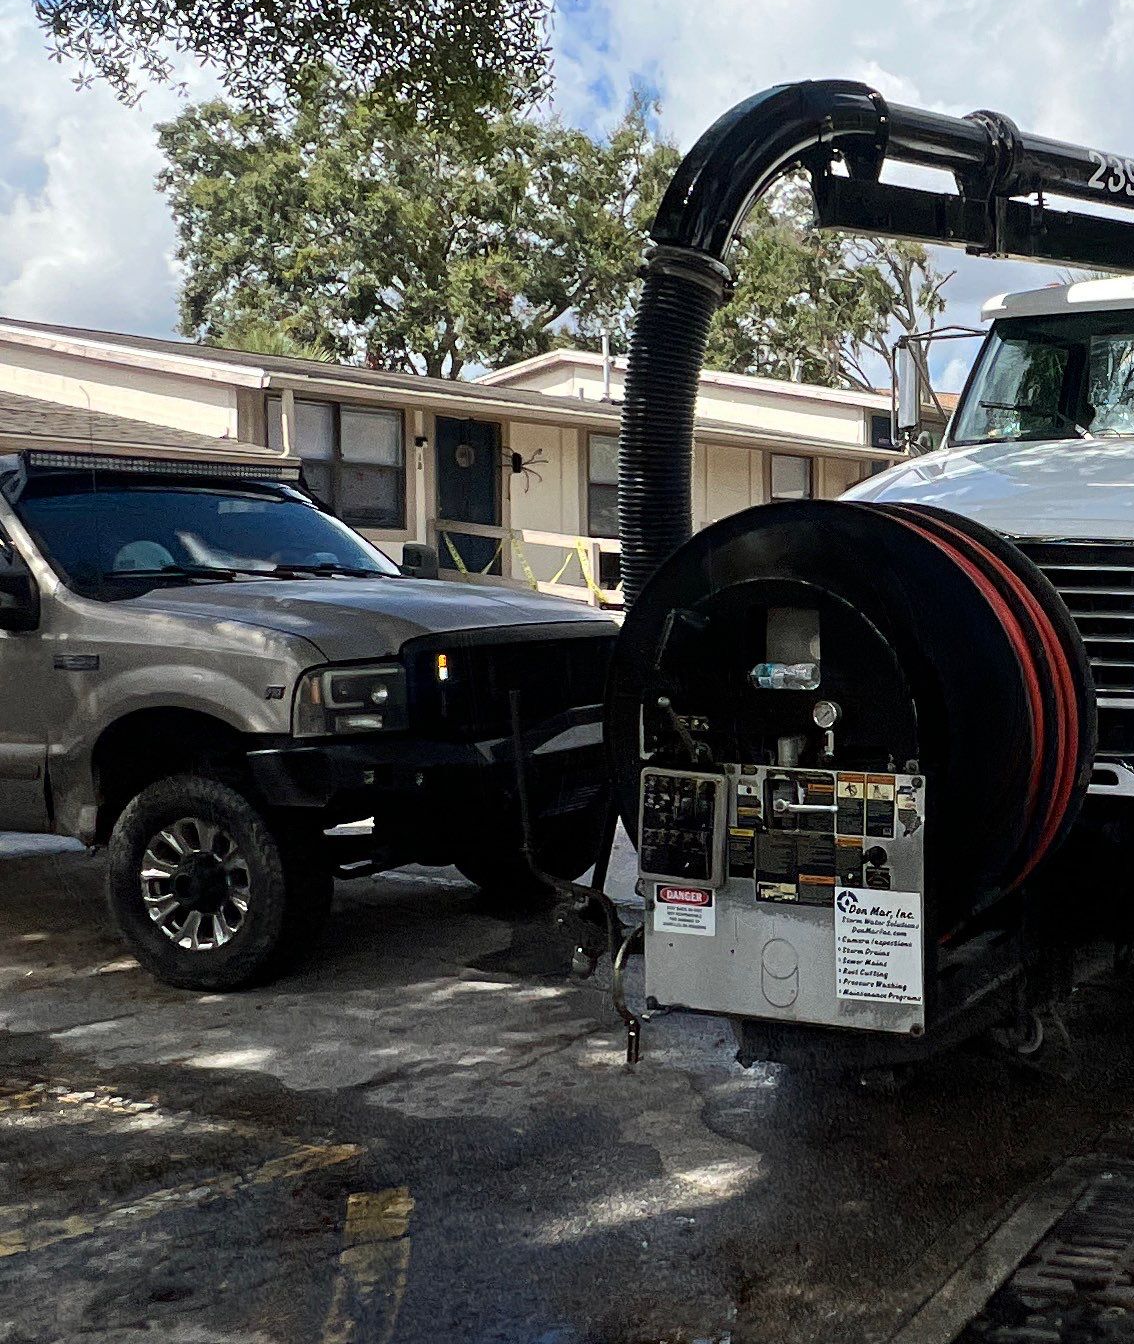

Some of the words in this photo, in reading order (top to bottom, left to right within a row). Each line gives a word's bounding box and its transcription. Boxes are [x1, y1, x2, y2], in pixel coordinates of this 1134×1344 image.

[666, 889, 702, 902] DANGER
[849, 905, 867, 915] Don
[870, 906, 892, 919] Mar,
[896, 908, 915, 919] Inc.
[842, 916, 863, 924] Storm
[842, 947, 863, 955] Storm
[876, 981, 907, 992] Washing
